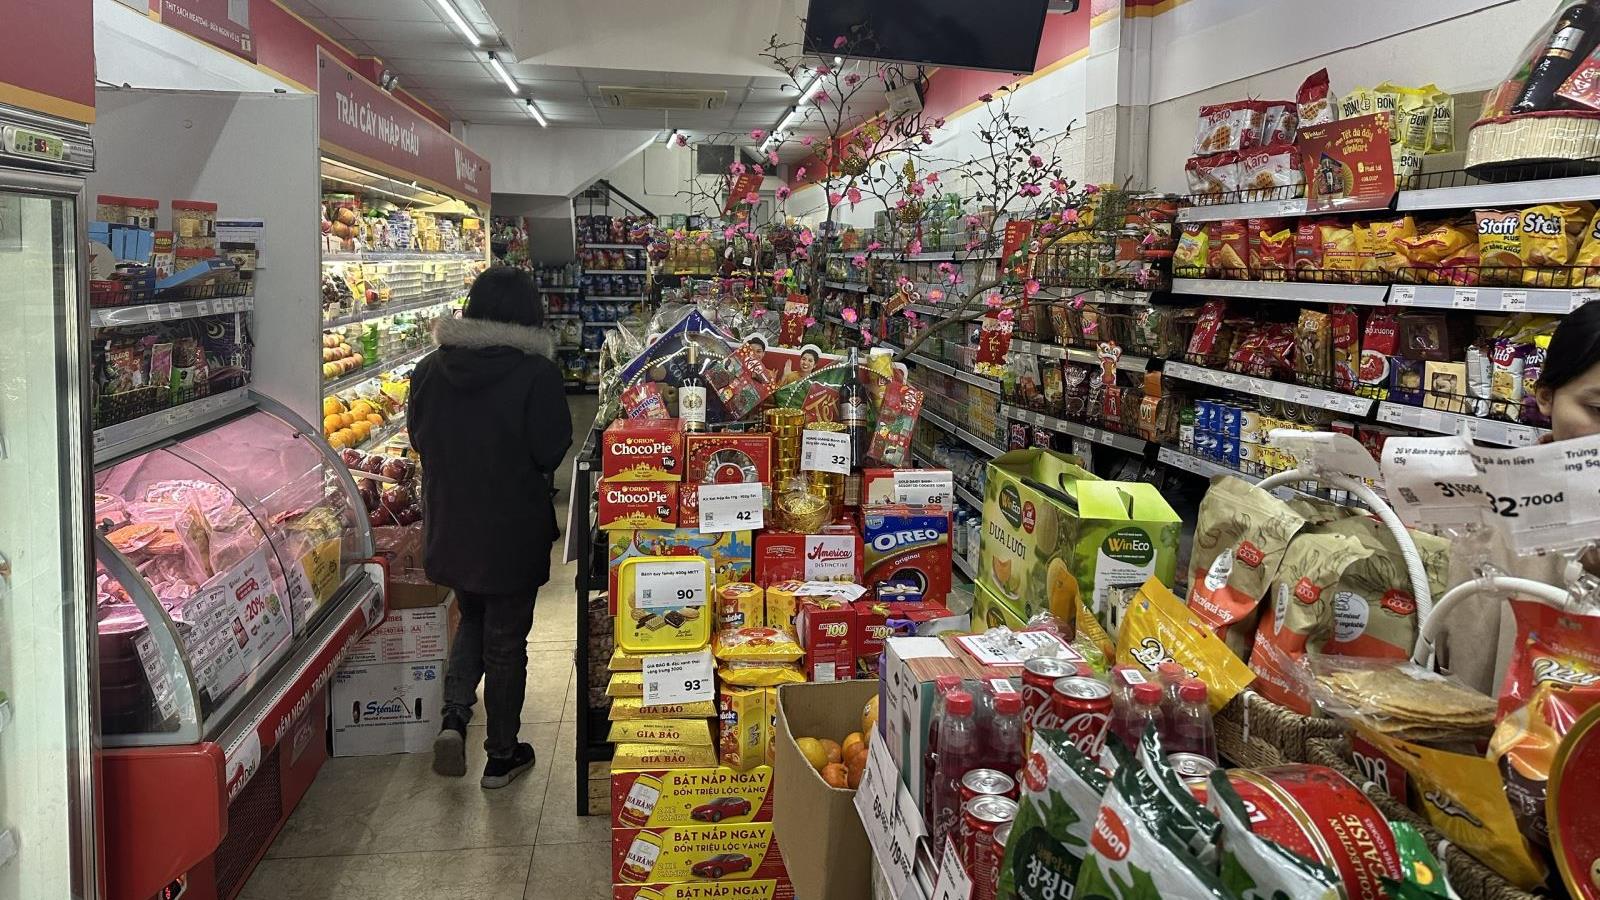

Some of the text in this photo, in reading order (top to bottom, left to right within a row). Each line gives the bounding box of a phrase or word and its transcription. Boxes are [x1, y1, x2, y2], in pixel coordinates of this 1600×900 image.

[335, 91, 419, 157] TRÁI CÂY NHẬP KHẨU
[1208, 108, 1232, 126] Karo
[1244, 153, 1269, 173] Karo
[1478, 217, 1517, 234] Staff
[630, 393, 660, 419] mentos
[831, 455, 846, 465] 32
[928, 496, 942, 504] 68
[736, 511, 752, 521] 42
[874, 529, 939, 551] OREO
[989, 521, 1006, 546] DƯA
[807, 542, 853, 561] America
[1108, 537, 1150, 552] WinEco
[895, 553, 920, 566] Original
[677, 589, 694, 599] 90
[826, 622, 848, 637] 100
[684, 679, 701, 691] 93
[363, 700, 401, 716] Stemilt
[639, 705, 658, 714] GIA
[636, 729, 680, 739] GIA BẢO
[641, 753, 686, 764] GIA BẢO
[673, 770, 766, 785] BẬT NẮP NGAY
[673, 785, 766, 796] ĐÓN TRIỆU LỘC VÀNG
[674, 827, 766, 841] BẬT NẮP NGAY
[673, 841, 767, 852] ĐÓN TRIỆU LỘC VÀNG
[676, 883, 769, 899] BẬT NẮP NGAY
